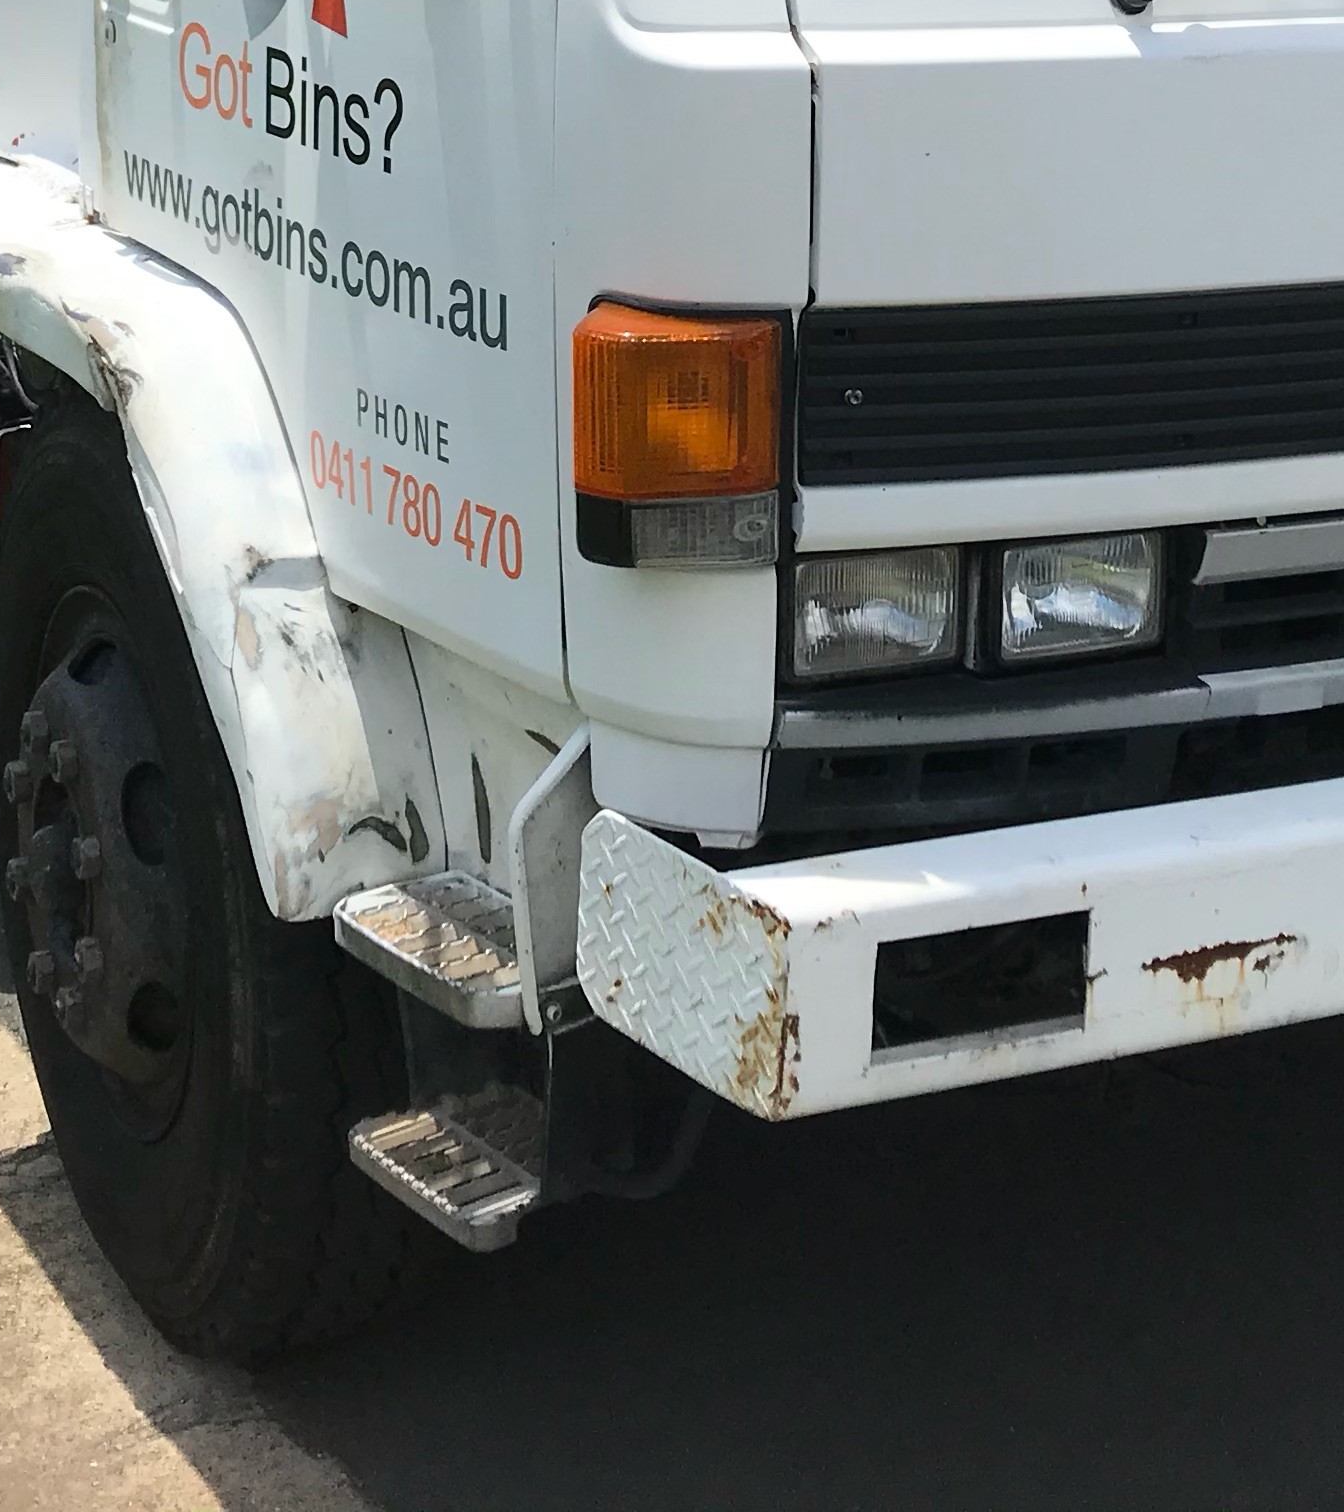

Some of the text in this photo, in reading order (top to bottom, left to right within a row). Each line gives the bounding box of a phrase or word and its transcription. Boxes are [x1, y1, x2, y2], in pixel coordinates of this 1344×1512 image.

[178, 22, 404, 174] Got Bins?
[123, 149, 509, 351] www.gotbins.com.au
[355, 387, 450, 464] PHONE
[309, 430, 523, 580] 0411 780 470
